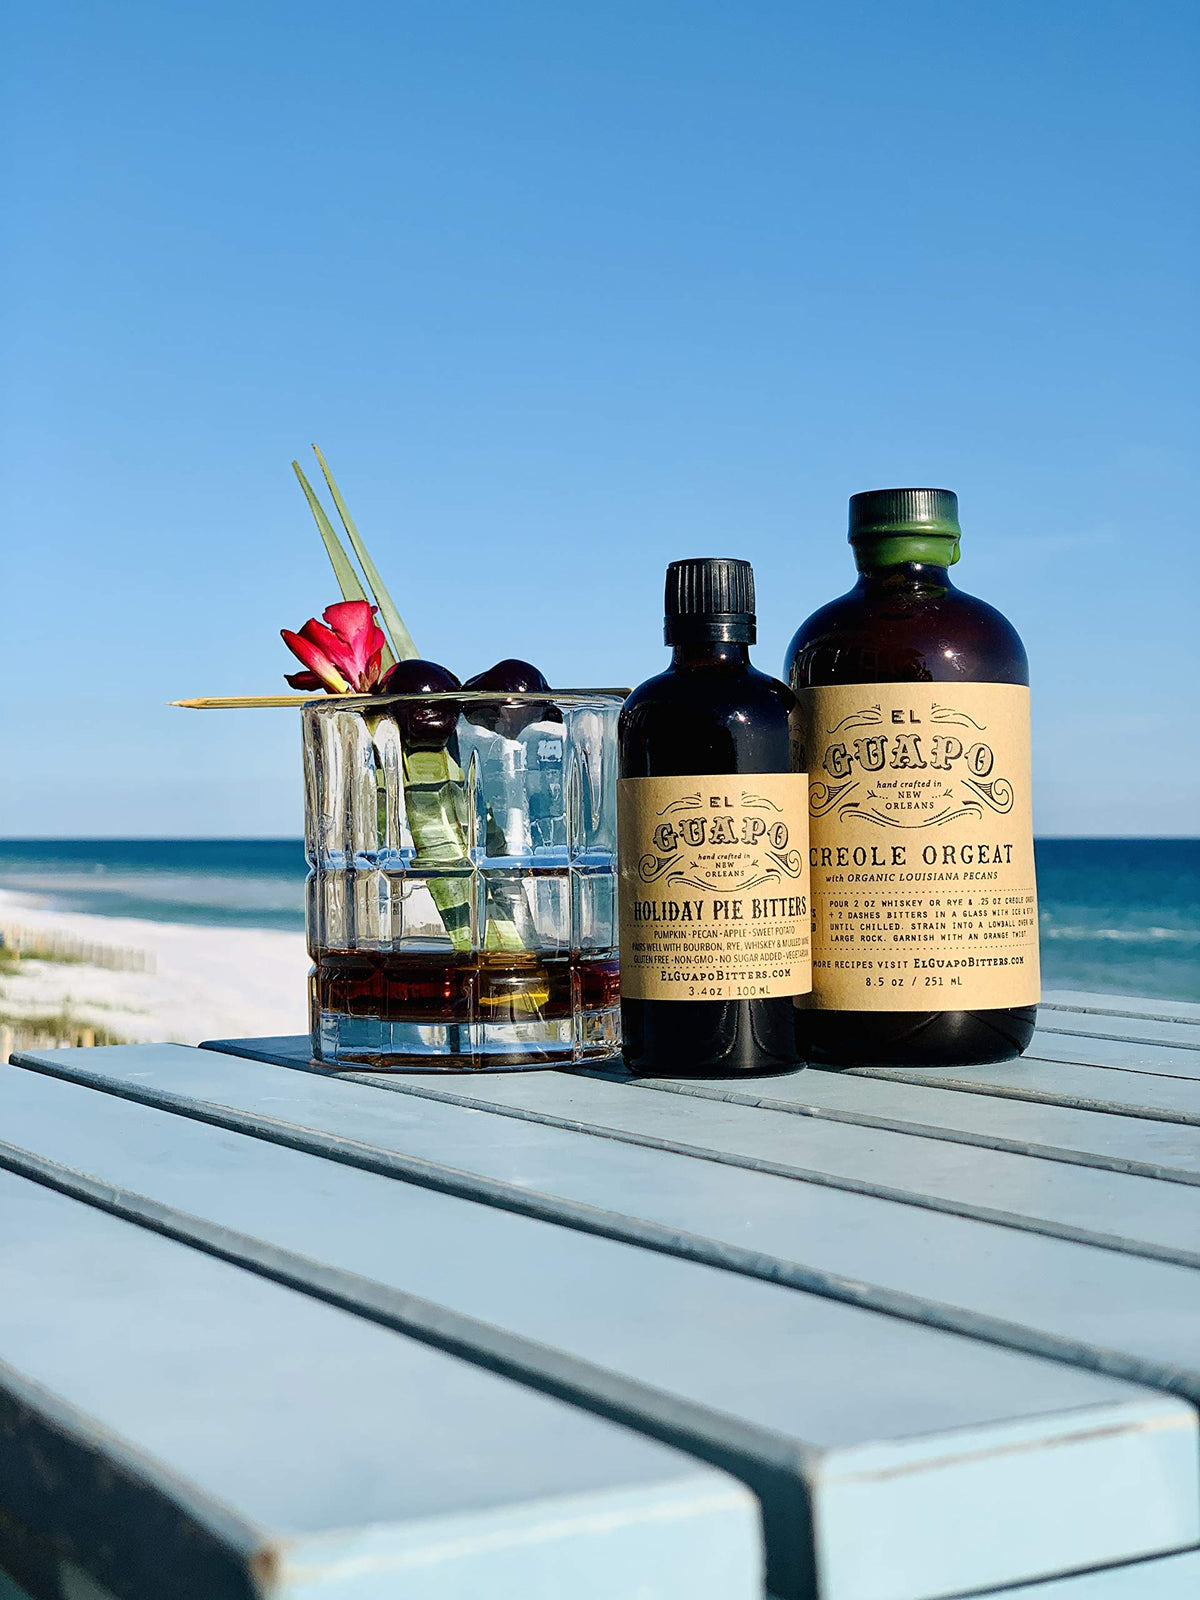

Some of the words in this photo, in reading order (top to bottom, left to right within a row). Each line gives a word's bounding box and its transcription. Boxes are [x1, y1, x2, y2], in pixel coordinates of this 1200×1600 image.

[892, 710, 922, 724] EL
[823, 734, 995, 778] GUAPO
[876, 780, 897, 788] hand
[901, 780, 932, 789] crafted
[933, 780, 942, 788] in
[898, 791, 921, 799] NEW
[709, 796, 733, 808] EL
[885, 801, 934, 810] ORLEANS
[652, 816, 788, 852] GUAPO
[697, 852, 715, 860] hand
[716, 852, 742, 860] crafted
[809, 846, 907, 867] CREOLE
[922, 844, 1013, 865] ORGEAT
[705, 870, 745, 878] ORLEANS
[826, 874, 844, 882] with
[847, 873, 896, 882] ORGANIC
[899, 873, 959, 882] LOUISIANA
[963, 872, 998, 880] PECANS
[829, 900, 849, 908] POUR
[854, 900, 859, 908] 2
[864, 900, 876, 908] OZ
[882, 899, 923, 907] WHISKEY
[978, 897, 989, 905] .25
[1005, 896, 1024, 904] CREOLE
[634, 900, 704, 921] HOLIDAY
[713, 900, 743, 920] PIE
[752, 895, 807, 919] BITTERS
[838, 911, 843, 919] 2
[848, 911, 881, 919] DASHES
[1012, 908, 1021, 916] ICE
[830, 923, 855, 931] UNTIL
[860, 923, 904, 931] CHILLED.
[911, 922, 946, 930] STRAIN
[953, 922, 973, 930] INTO
[978, 921, 983, 929] A
[988, 920, 1015, 929] LOWBALL
[654, 930, 687, 939] PUMPKIN
[692, 930, 718, 939] PECAN
[723, 929, 746, 938] APPLE
[752, 927, 774, 937] SWEET
[776, 926, 795, 936] POTATO
[830, 934, 855, 942] LARGE
[860, 934, 887, 942] ROCK.
[893, 934, 935, 942] GARNISH
[983, 931, 1009, 940] ORANGE
[646, 942, 662, 952] WELL
[663, 943, 681, 952] WITH
[683, 942, 725, 952] BOURBON,
[726, 942, 743, 952] RYE,
[744, 939, 776, 950] WHISKEY
[776, 939, 781, 948] &
[634, 955, 653, 964] GLUTEN
[654, 955, 669, 964] FREE
[674, 955, 714, 964] NON-GMO
[719, 954, 732, 963] NO
[733, 953, 759, 963] SUGAR
[760, 952, 782, 961] ADDED
[834, 960, 873, 969] RECIPES
[878, 961, 908, 969] VISIT
[865, 977, 885, 987] 8.5
[925, 976, 943, 986] 251
[737, 986, 756, 996] 100
